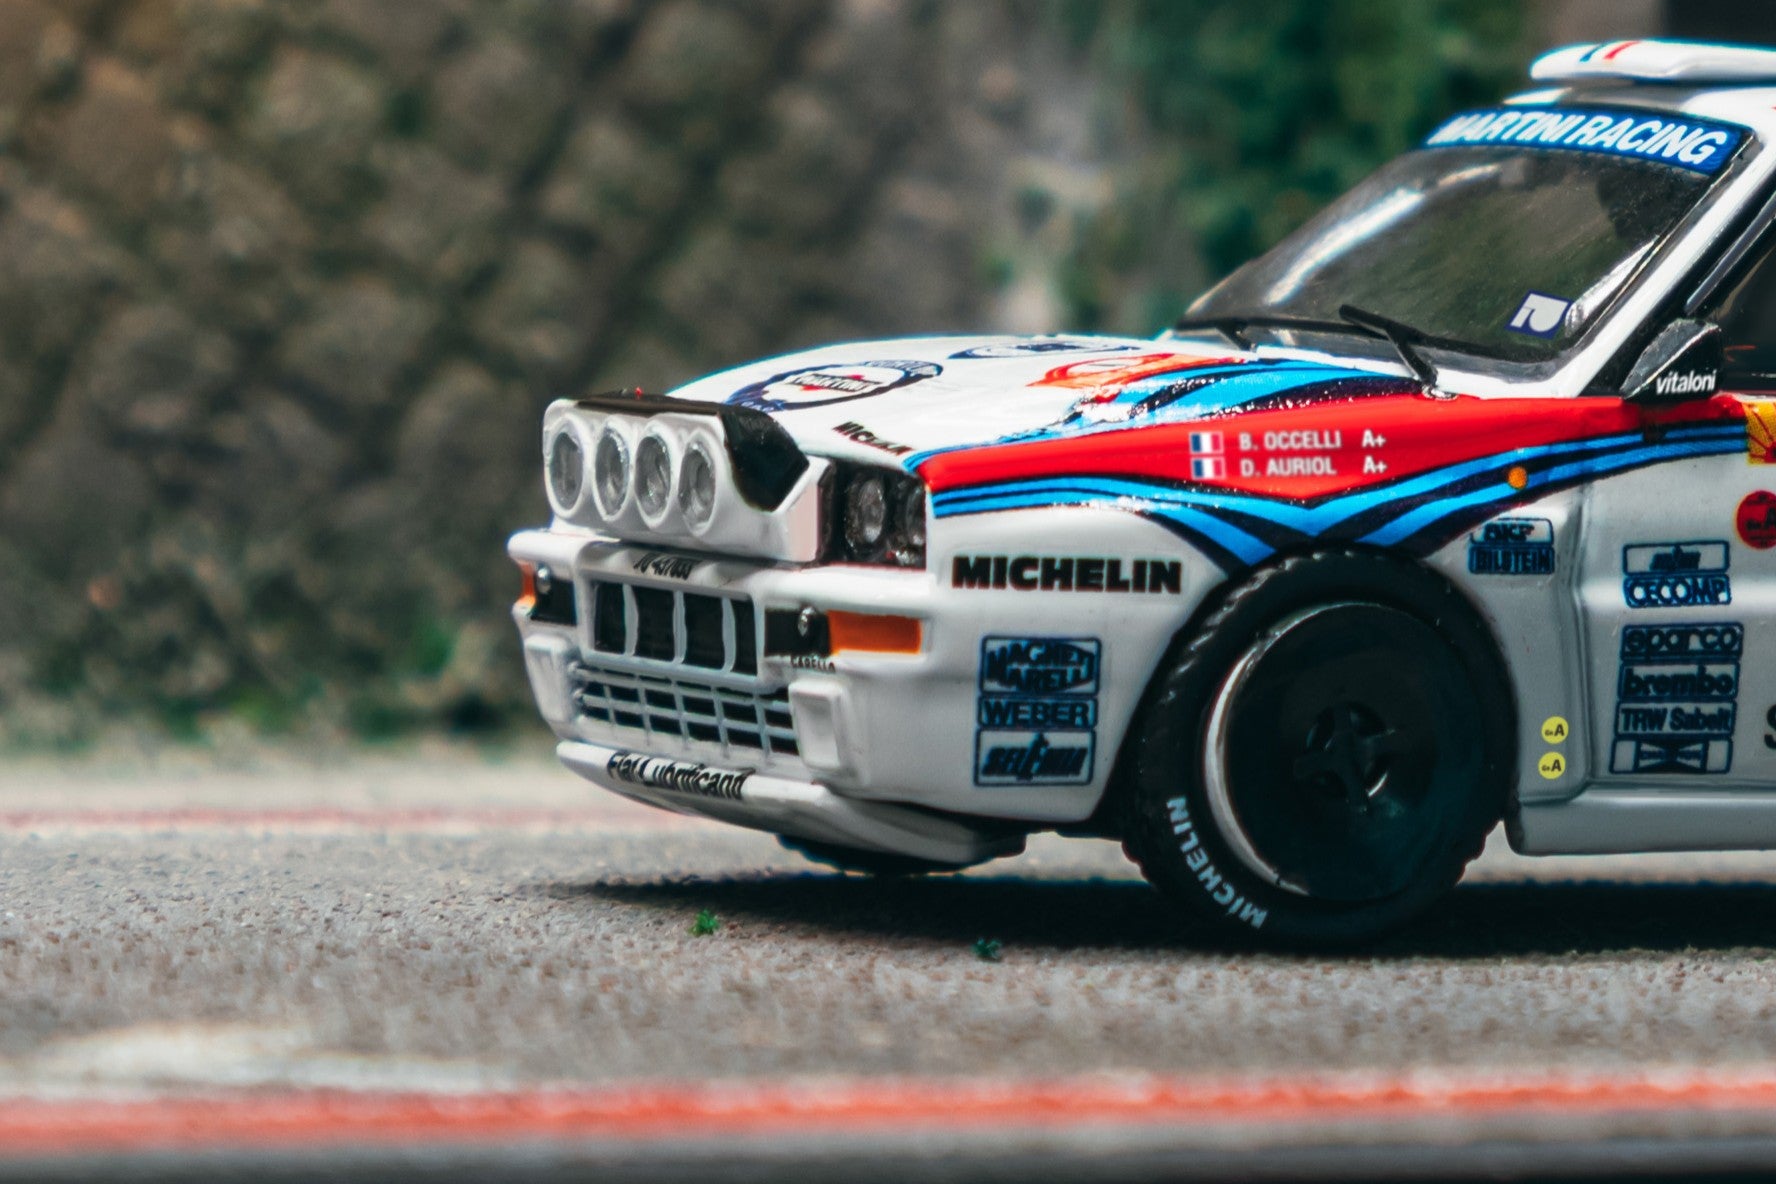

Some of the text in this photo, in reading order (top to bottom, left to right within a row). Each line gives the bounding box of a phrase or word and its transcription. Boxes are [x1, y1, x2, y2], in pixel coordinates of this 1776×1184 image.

[1426, 111, 1728, 164] MARTINI RACING
[1656, 368, 1717, 395] vitaloni
[1238, 428, 1387, 451] B. OCCELLI A+
[1240, 455, 1388, 477] D. AURIOL A+
[951, 555, 1182, 595] MICHELIN
[1622, 667, 1734, 696] brembo
[983, 698, 1092, 727] WEBER
[1166, 795, 1268, 929] MICHELIN
